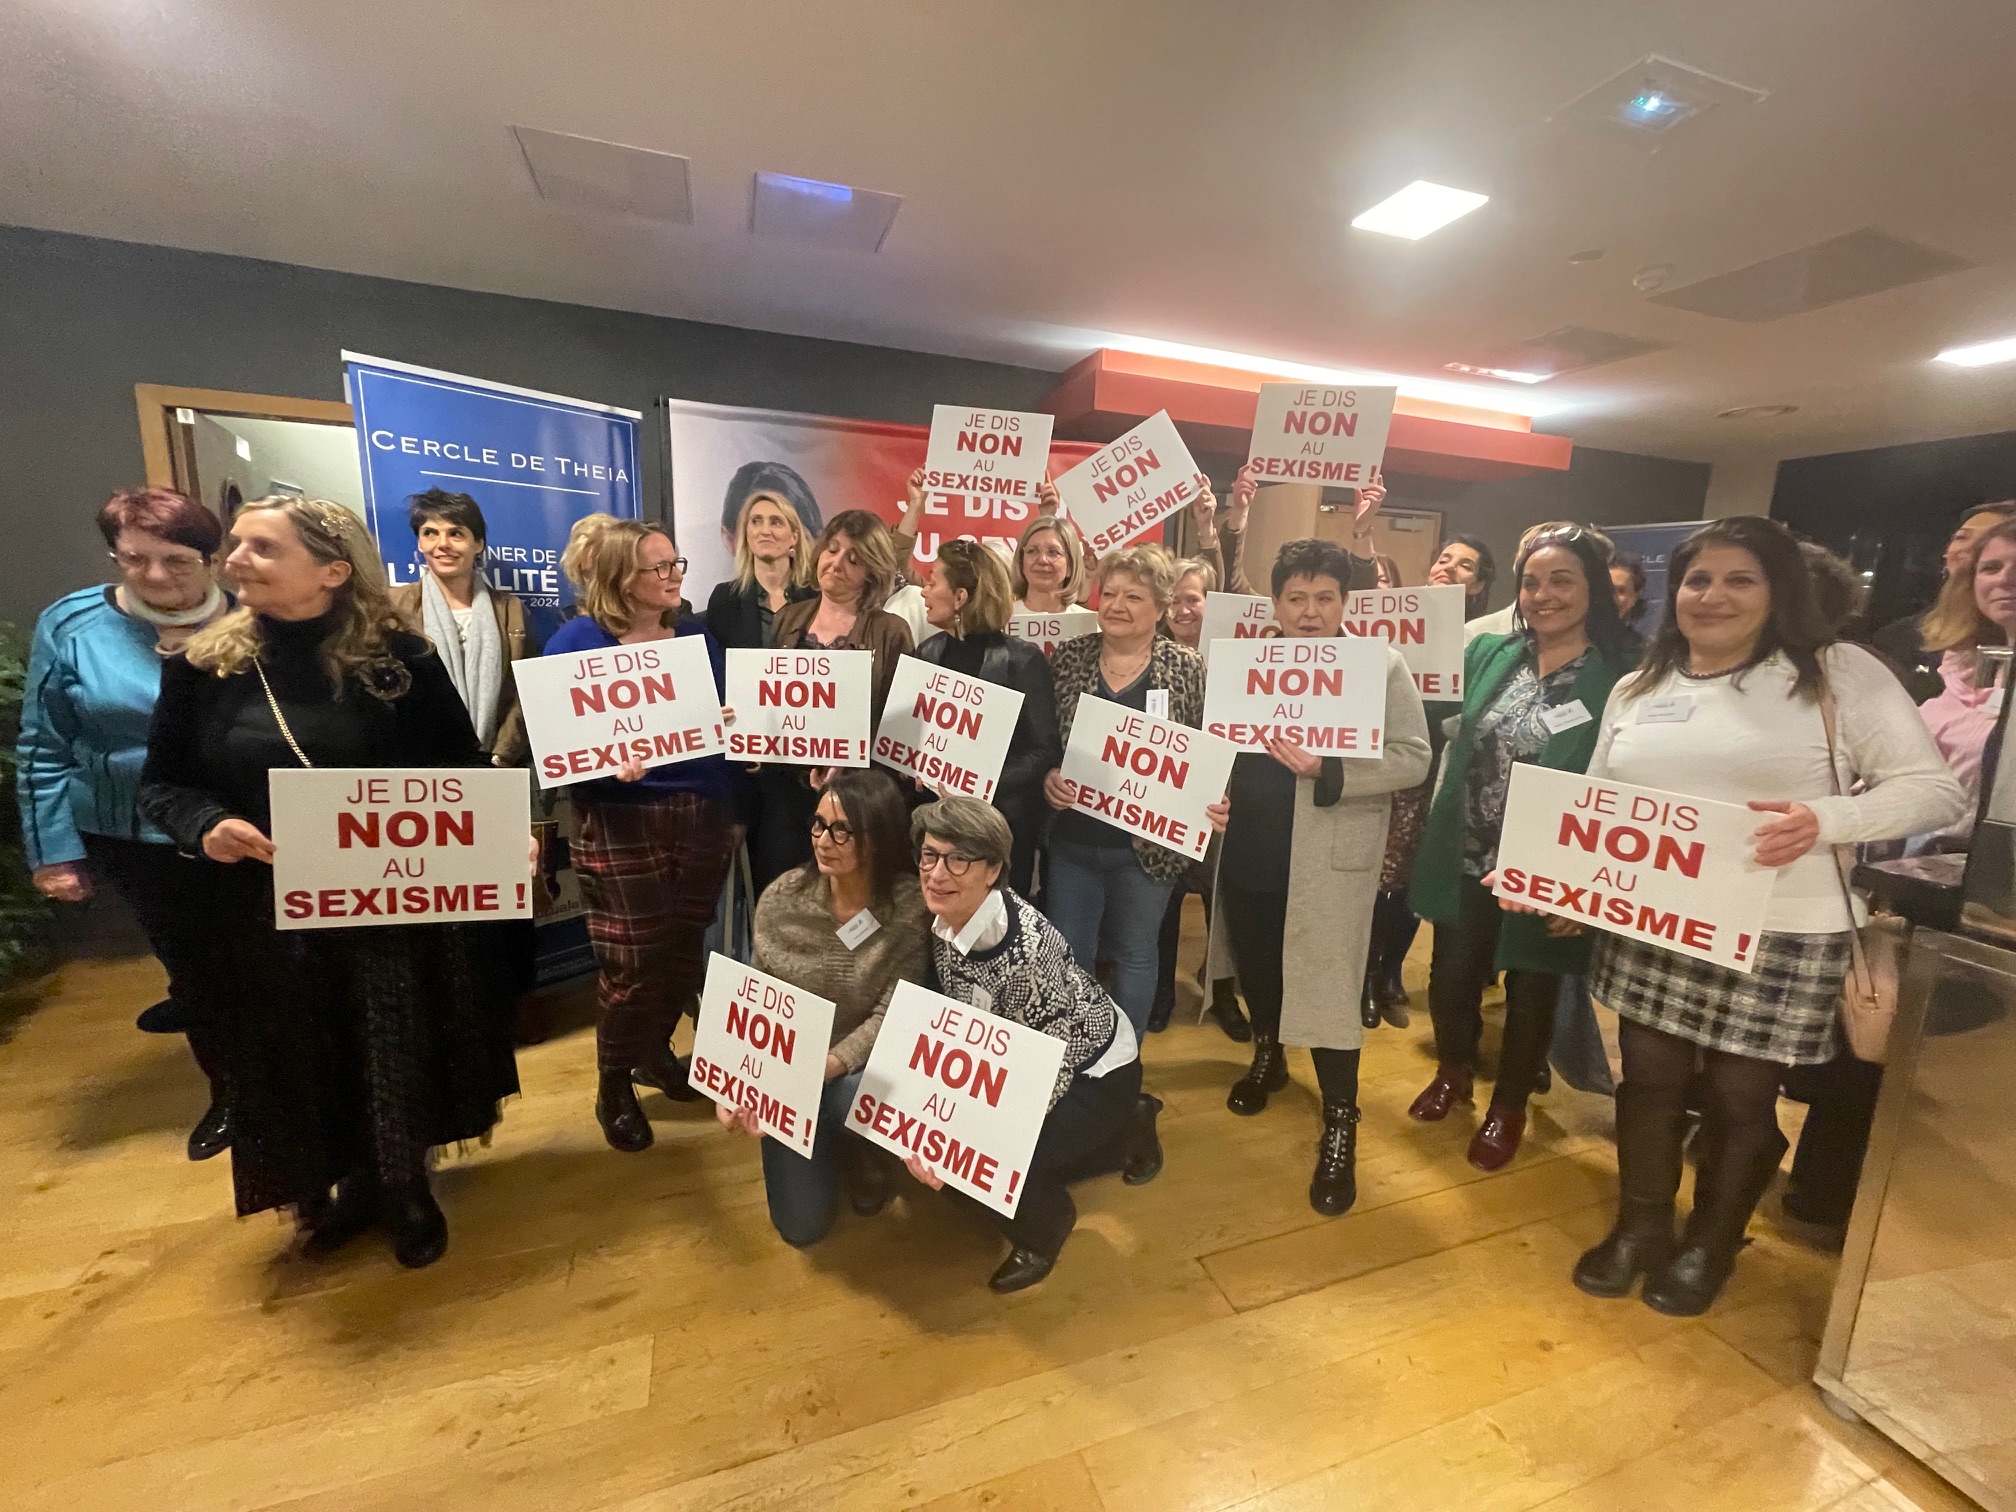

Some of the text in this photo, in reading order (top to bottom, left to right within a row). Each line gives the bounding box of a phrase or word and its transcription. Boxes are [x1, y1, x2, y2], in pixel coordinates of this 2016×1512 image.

[1294, 390, 1356, 407] JE DIS
[965, 413, 1020, 431] JE DIS
[1283, 411, 1358, 437] NON
[371, 430, 629, 483] CERCLE DE THEIA
[957, 431, 1022, 457] NON
[1090, 435, 1143, 478] JE DIS
[1301, 441, 1324, 455] AU
[973, 458, 995, 472] AU
[1092, 449, 1161, 504] NON
[1250, 457, 1361, 482] SEXISME
[928, 471, 1027, 496] SEXISME
[1127, 486, 1146, 508] AU
[964, 494, 1029, 521] DIS
[1093, 481, 1191, 551] SEXISME
[533, 549, 556, 564] DE
[530, 597, 559, 607] 2024
[1243, 602, 1267, 620] JE
[1349, 594, 1419, 615] JE DIS
[1028, 620, 1061, 637] DIS
[574, 649, 661, 680] JE DIS
[764, 656, 830, 675] JE DIS
[1255, 645, 1337, 663] JE DIS
[570, 673, 676, 717] NON
[759, 680, 836, 709] NON
[926, 672, 984, 706] JE DIS
[1246, 668, 1343, 697] NON
[782, 715, 806, 730] AU
[912, 692, 983, 740] NON
[1273, 703, 1303, 719] AU
[612, 715, 643, 736] AU
[1116, 715, 1190, 753] JE DIS
[1208, 722, 1357, 750] SEXISME
[544, 728, 705, 779] SEXISME
[729, 733, 849, 760] SEXISME
[924, 732, 948, 752] AU
[877, 736, 978, 795] SEXISME
[1101, 736, 1190, 790] NON
[347, 778, 463, 804] JE DIS
[1119, 778, 1147, 799] AU
[1064, 778, 1188, 846] SEXISME
[1574, 786, 1699, 831] JE DIS
[338, 810, 474, 849] NON
[1558, 812, 1705, 879] NON
[383, 857, 424, 879] AU
[1591, 866, 1637, 892] AU
[283, 884, 499, 919] SEXISME
[1501, 867, 1717, 952] SEXISME
[737, 975, 796, 1020] JE DIS
[726, 1001, 796, 1065] NON
[931, 1006, 1011, 1057] JE DIS
[740, 1053, 763, 1079] AU
[908, 1033, 1008, 1107] NON
[693, 1056, 796, 1138] SEXISME
[922, 1092, 957, 1123] AU
[854, 1094, 999, 1193] SEXISME
